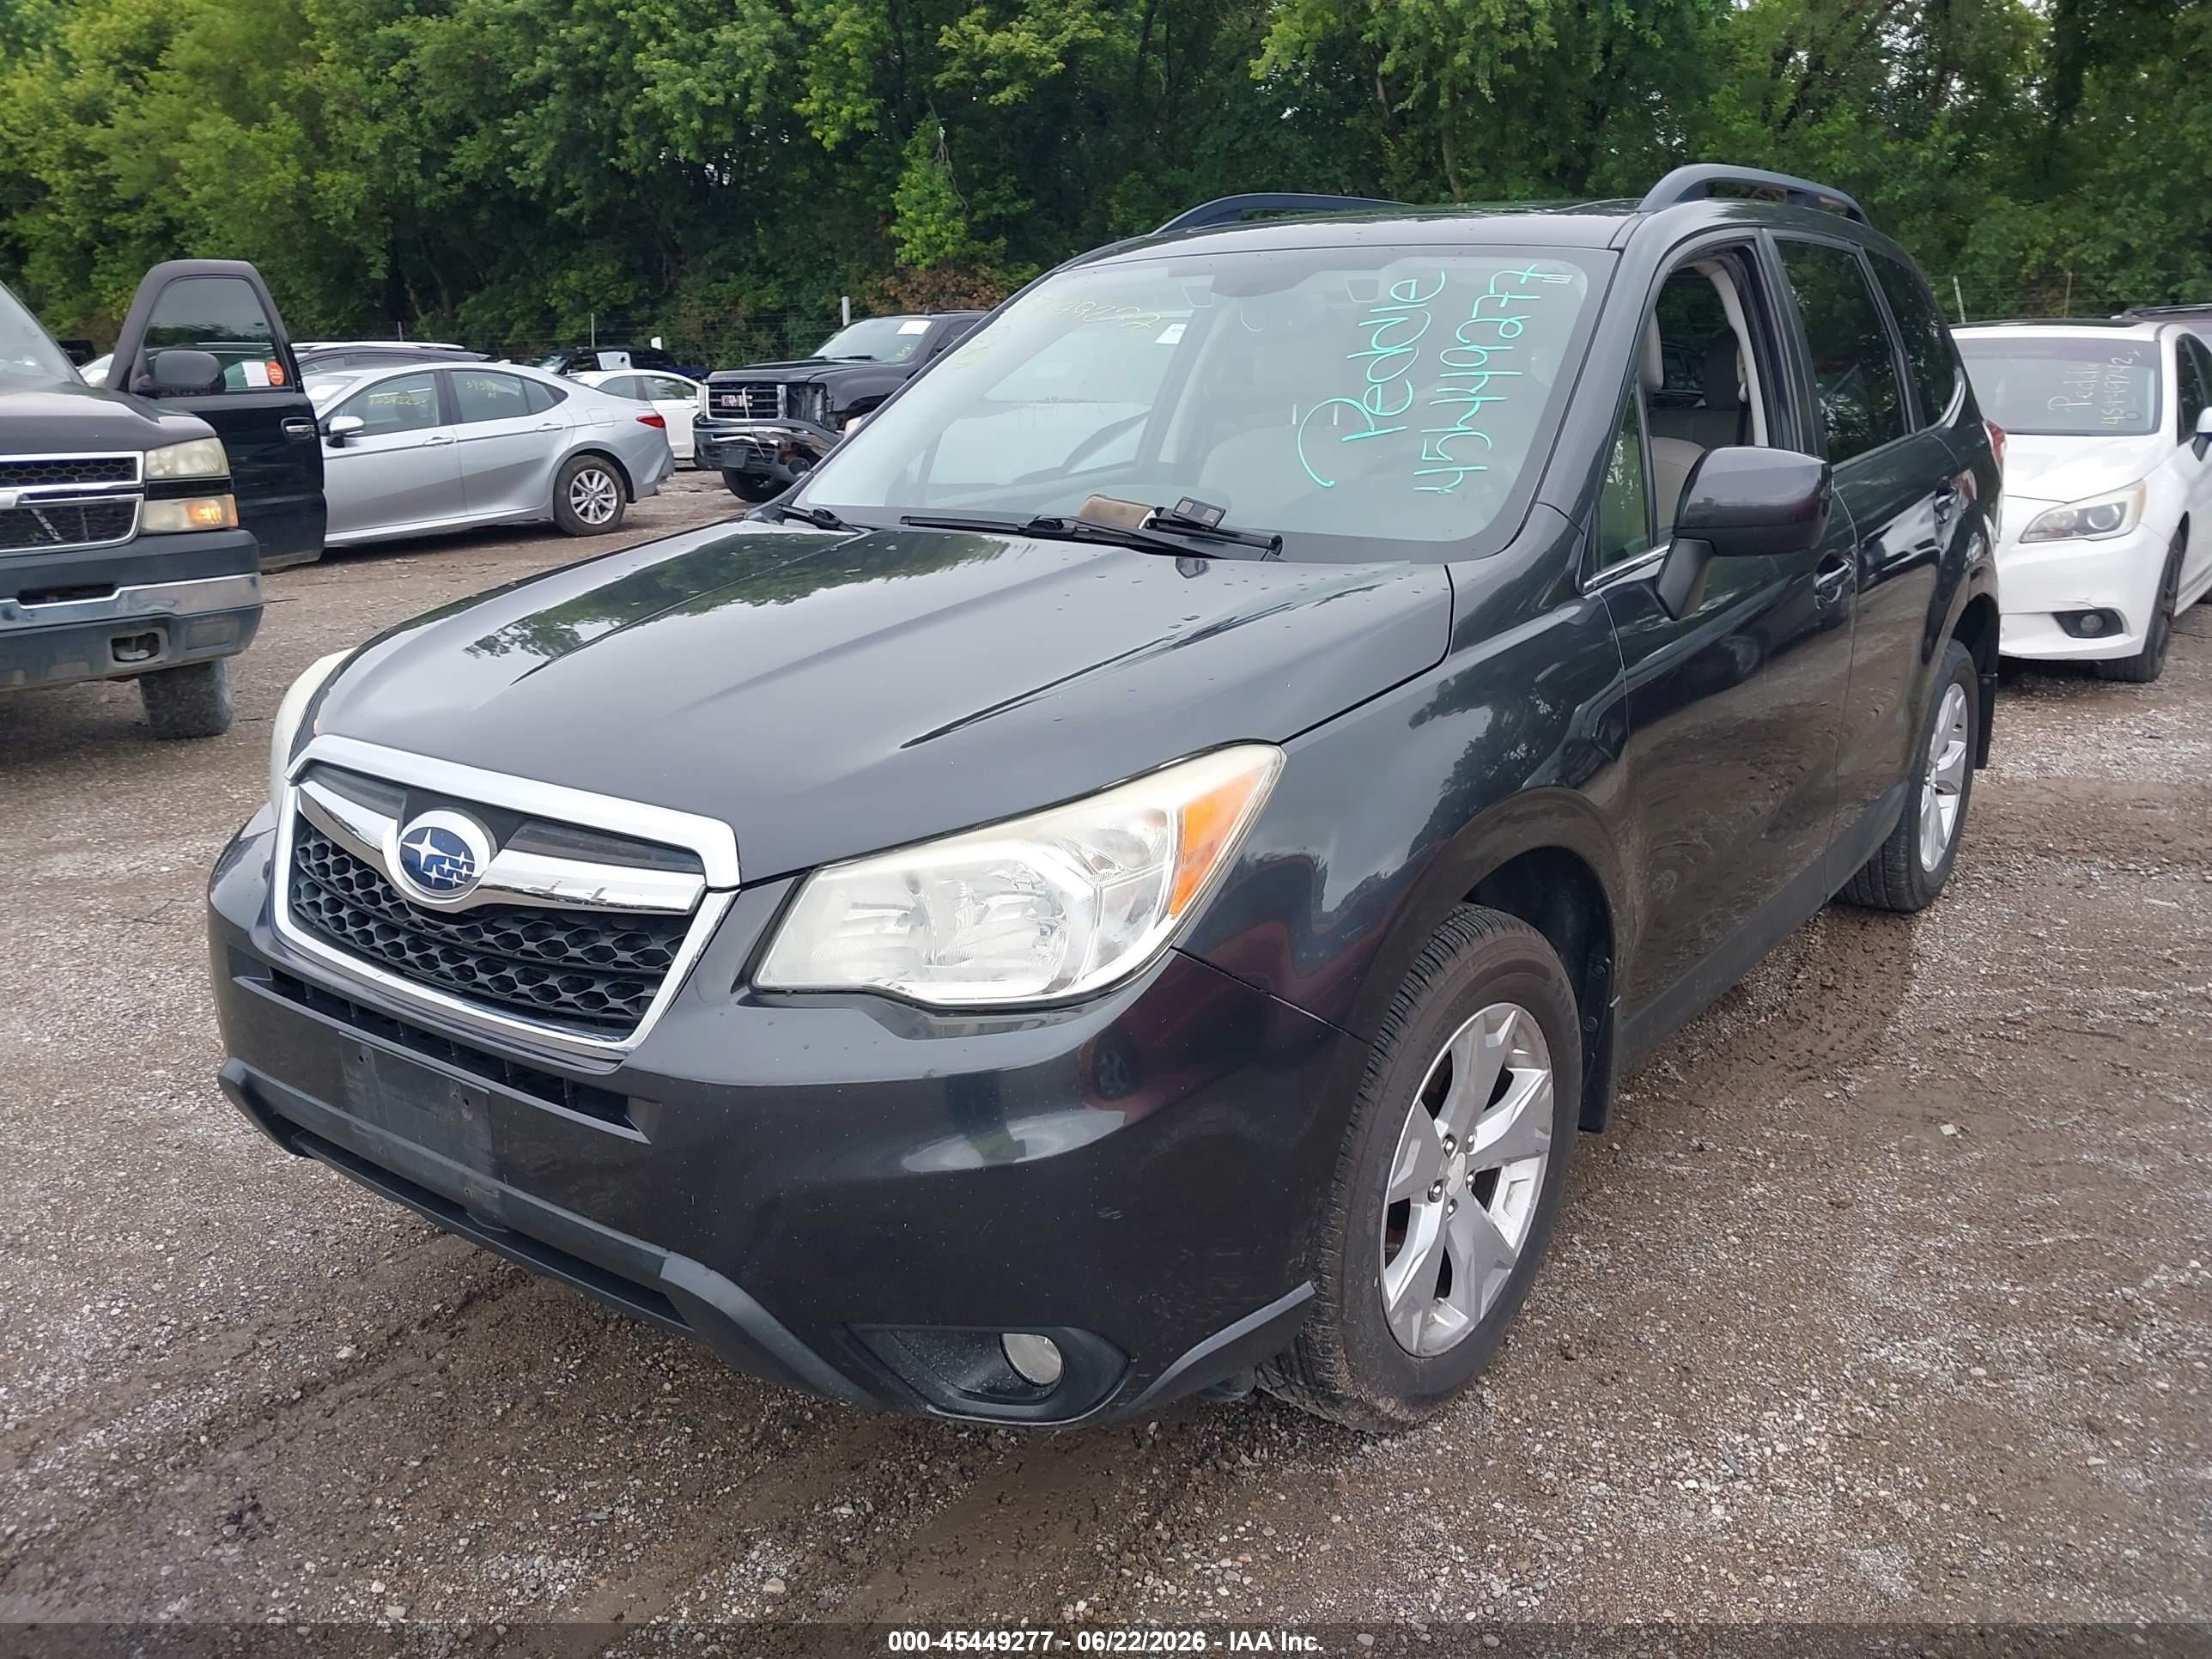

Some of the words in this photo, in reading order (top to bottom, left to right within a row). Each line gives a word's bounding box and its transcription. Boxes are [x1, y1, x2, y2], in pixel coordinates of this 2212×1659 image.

[720, 394, 754, 408] GMC
[1297, 270, 1447, 489] Peddle
[1413, 264, 1573, 495] 45449277
